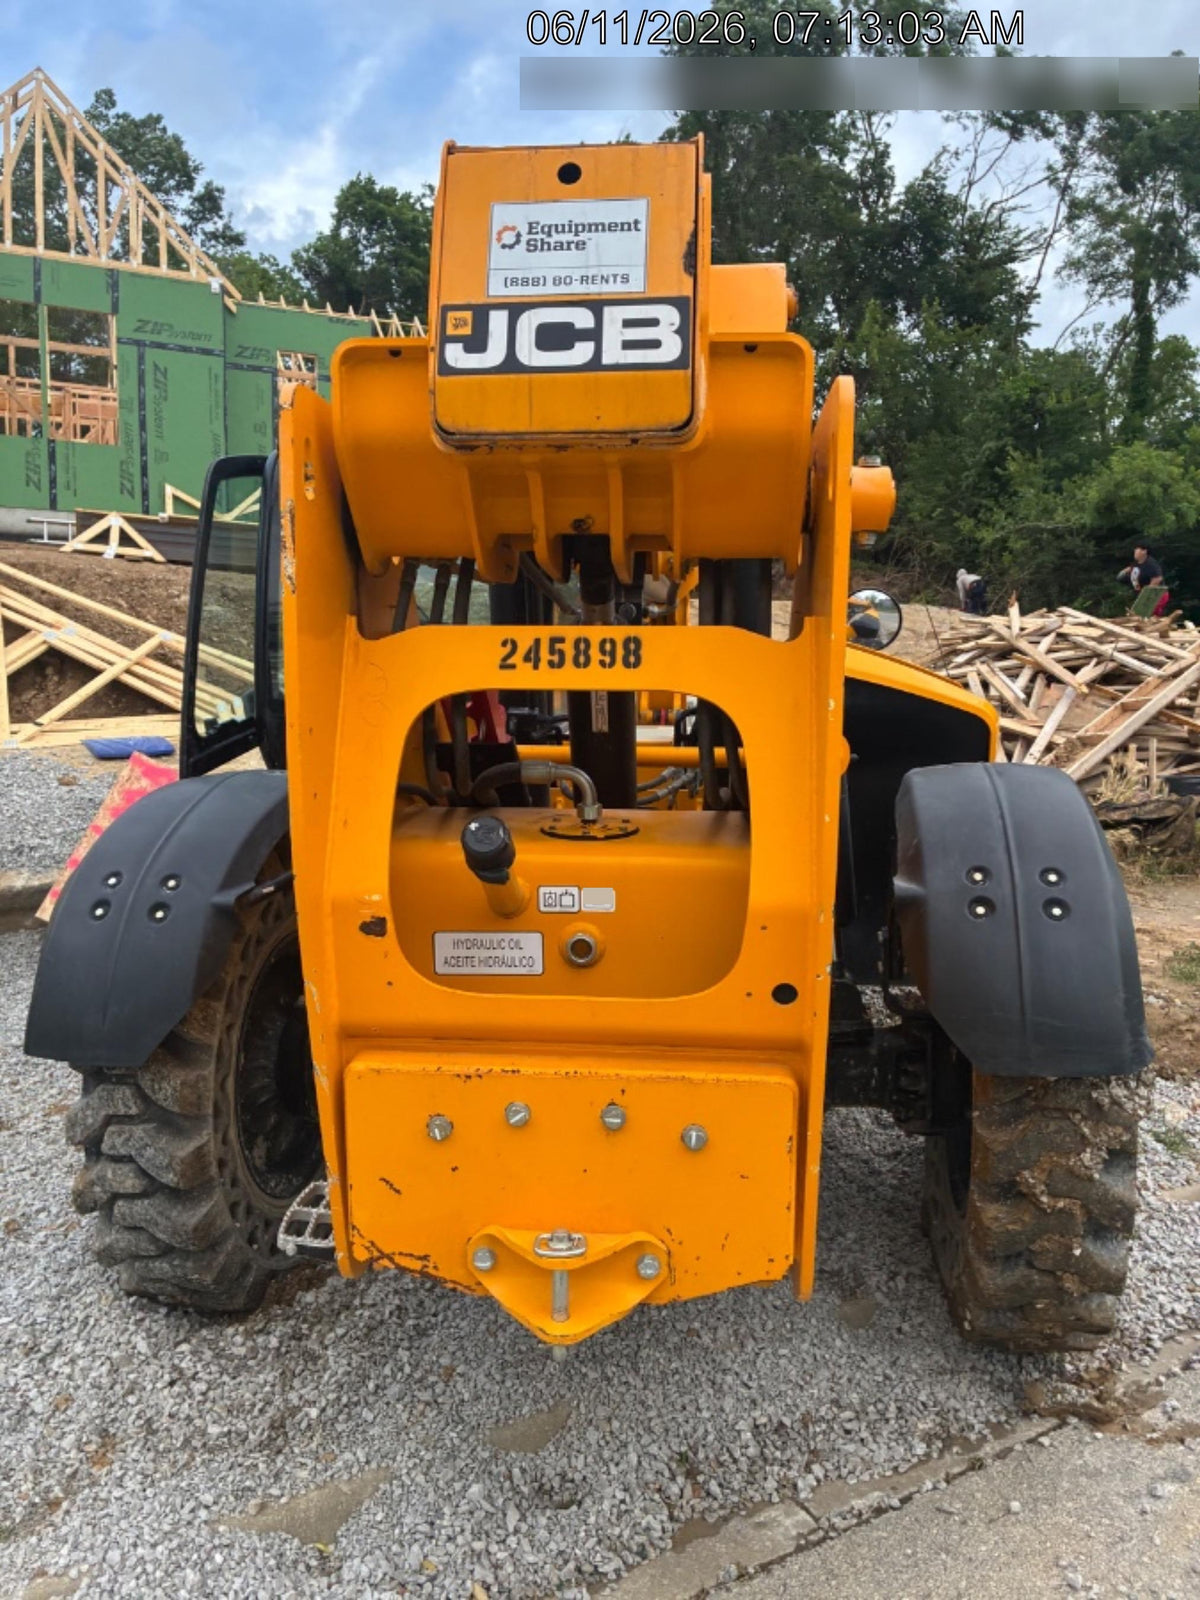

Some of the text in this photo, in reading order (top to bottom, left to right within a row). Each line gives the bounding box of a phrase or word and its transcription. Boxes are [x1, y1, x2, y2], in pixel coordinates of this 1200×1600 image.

[526, 218, 641, 238] Equipment
[525, 237, 588, 253] Share
[552, 273, 630, 287] 80-RENTS
[444, 304, 683, 369] JCB
[498, 636, 642, 670] 245898
[452, 938, 524, 951] HYDRAULIC OIL
[443, 955, 476, 968] ACEITE
